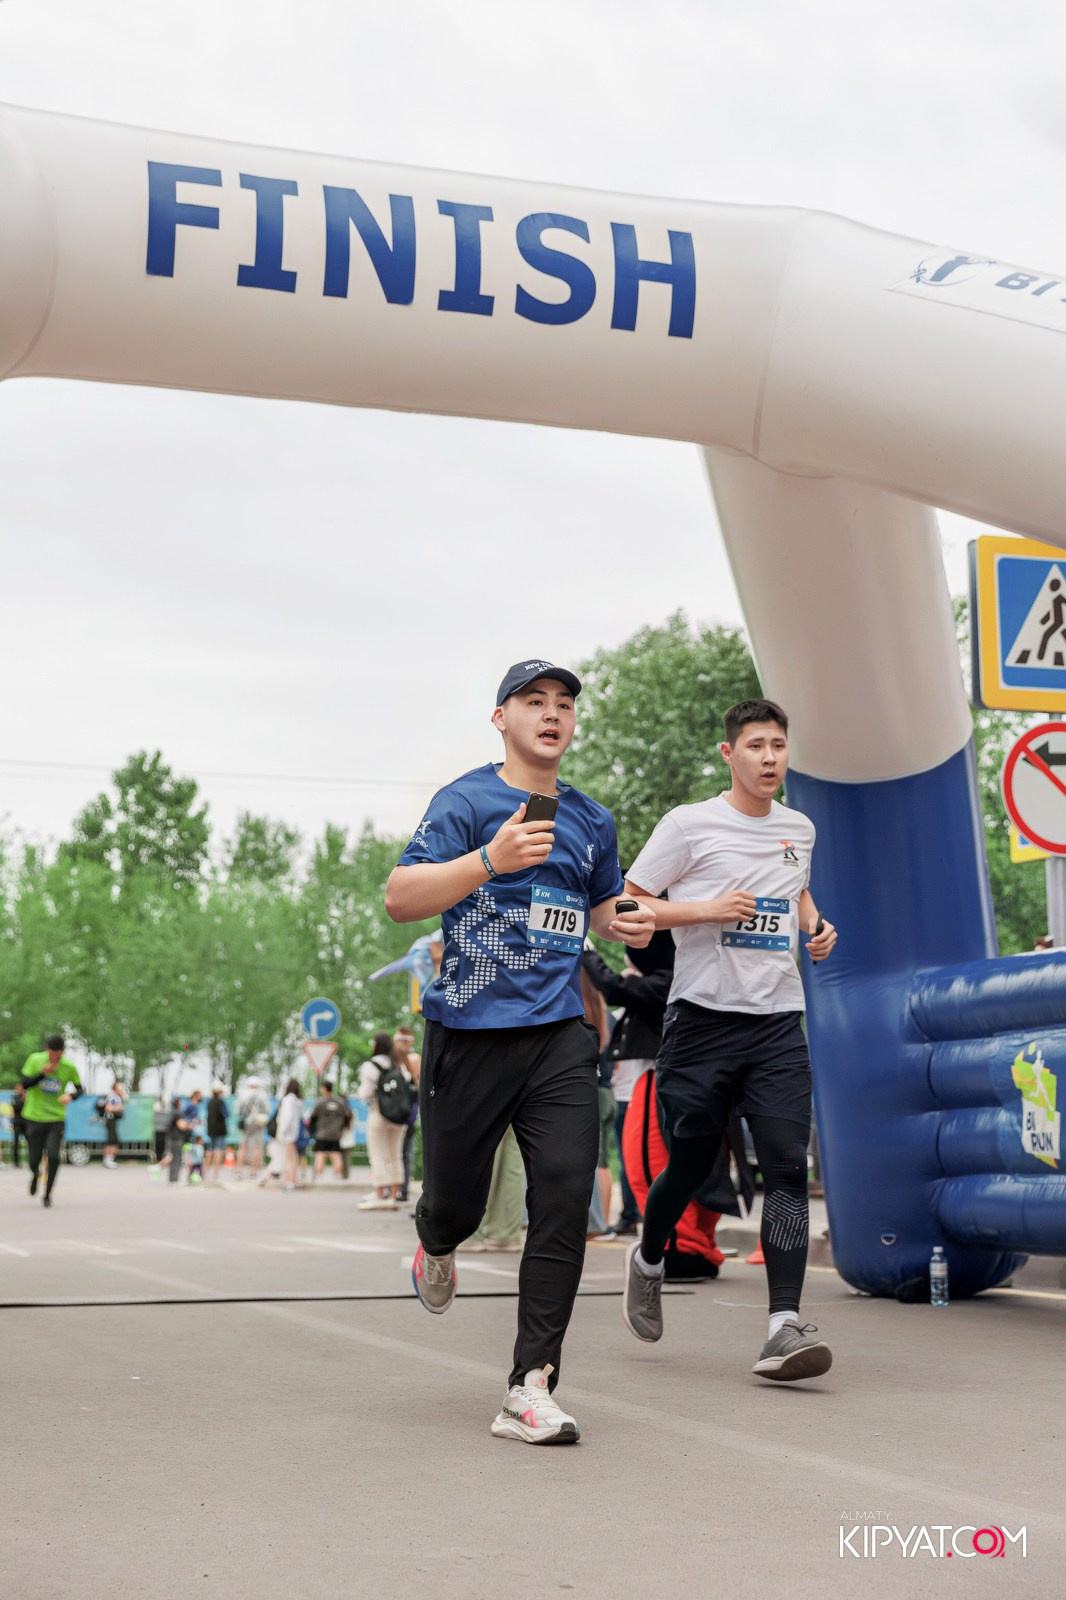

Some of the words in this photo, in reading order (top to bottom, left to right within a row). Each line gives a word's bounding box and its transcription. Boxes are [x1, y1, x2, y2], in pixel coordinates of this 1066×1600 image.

[145, 160, 697, 339] FINISH
[542, 907, 577, 933] 1119
[1031, 1132, 1054, 1152] RUN
